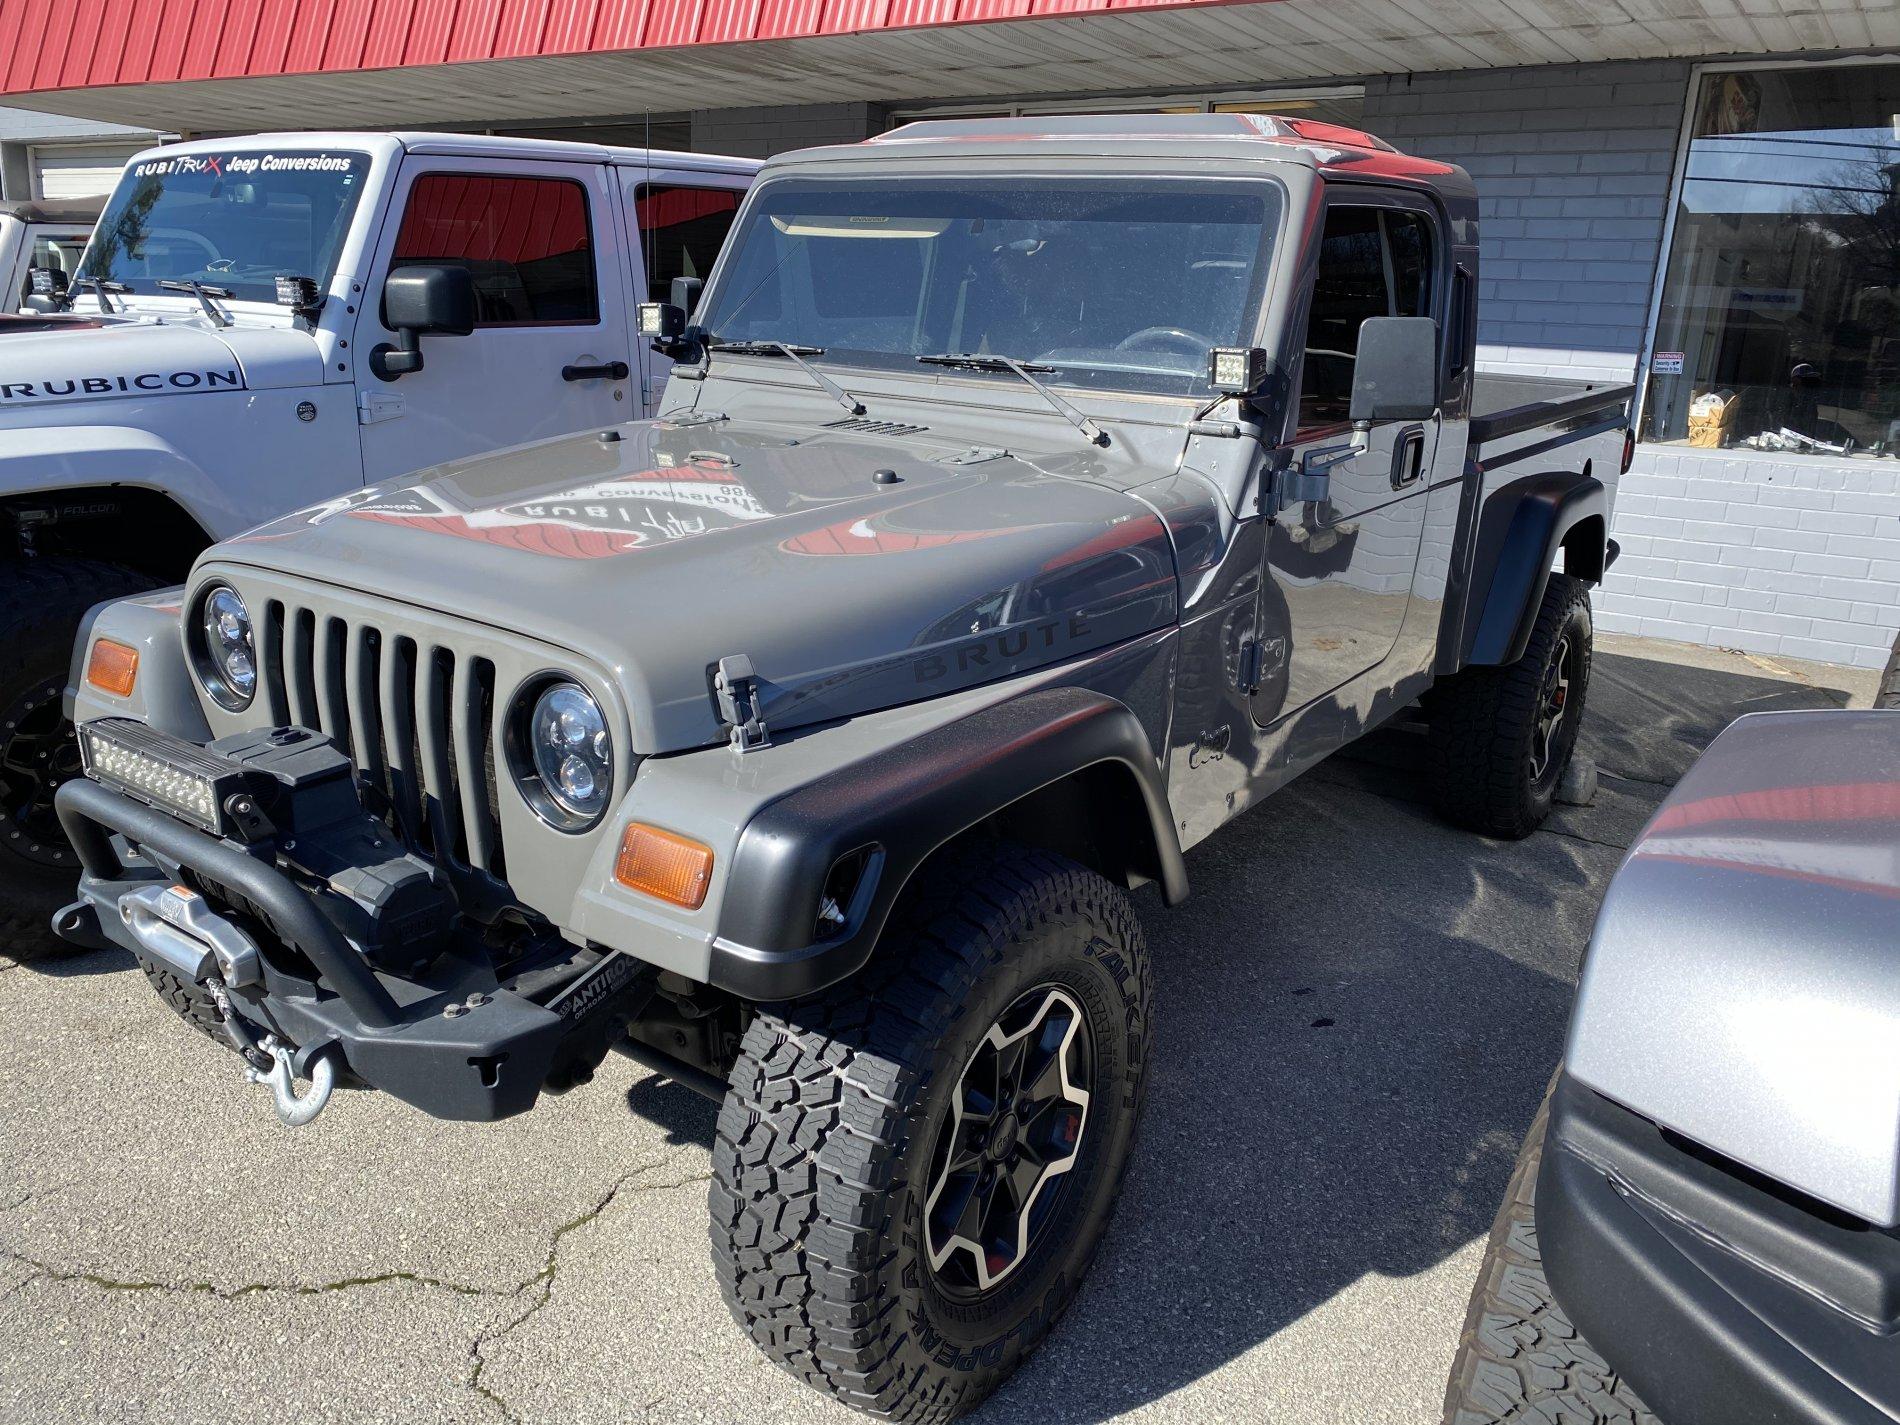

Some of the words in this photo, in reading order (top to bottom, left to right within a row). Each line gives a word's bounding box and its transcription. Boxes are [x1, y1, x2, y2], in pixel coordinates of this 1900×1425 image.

[225, 156, 257, 174] Jeep
[260, 153, 351, 172] Conversions
[0, 370, 238, 398] RUBICON
[63, 503, 116, 514] FALCON
[912, 616, 1092, 684] BRUTE
